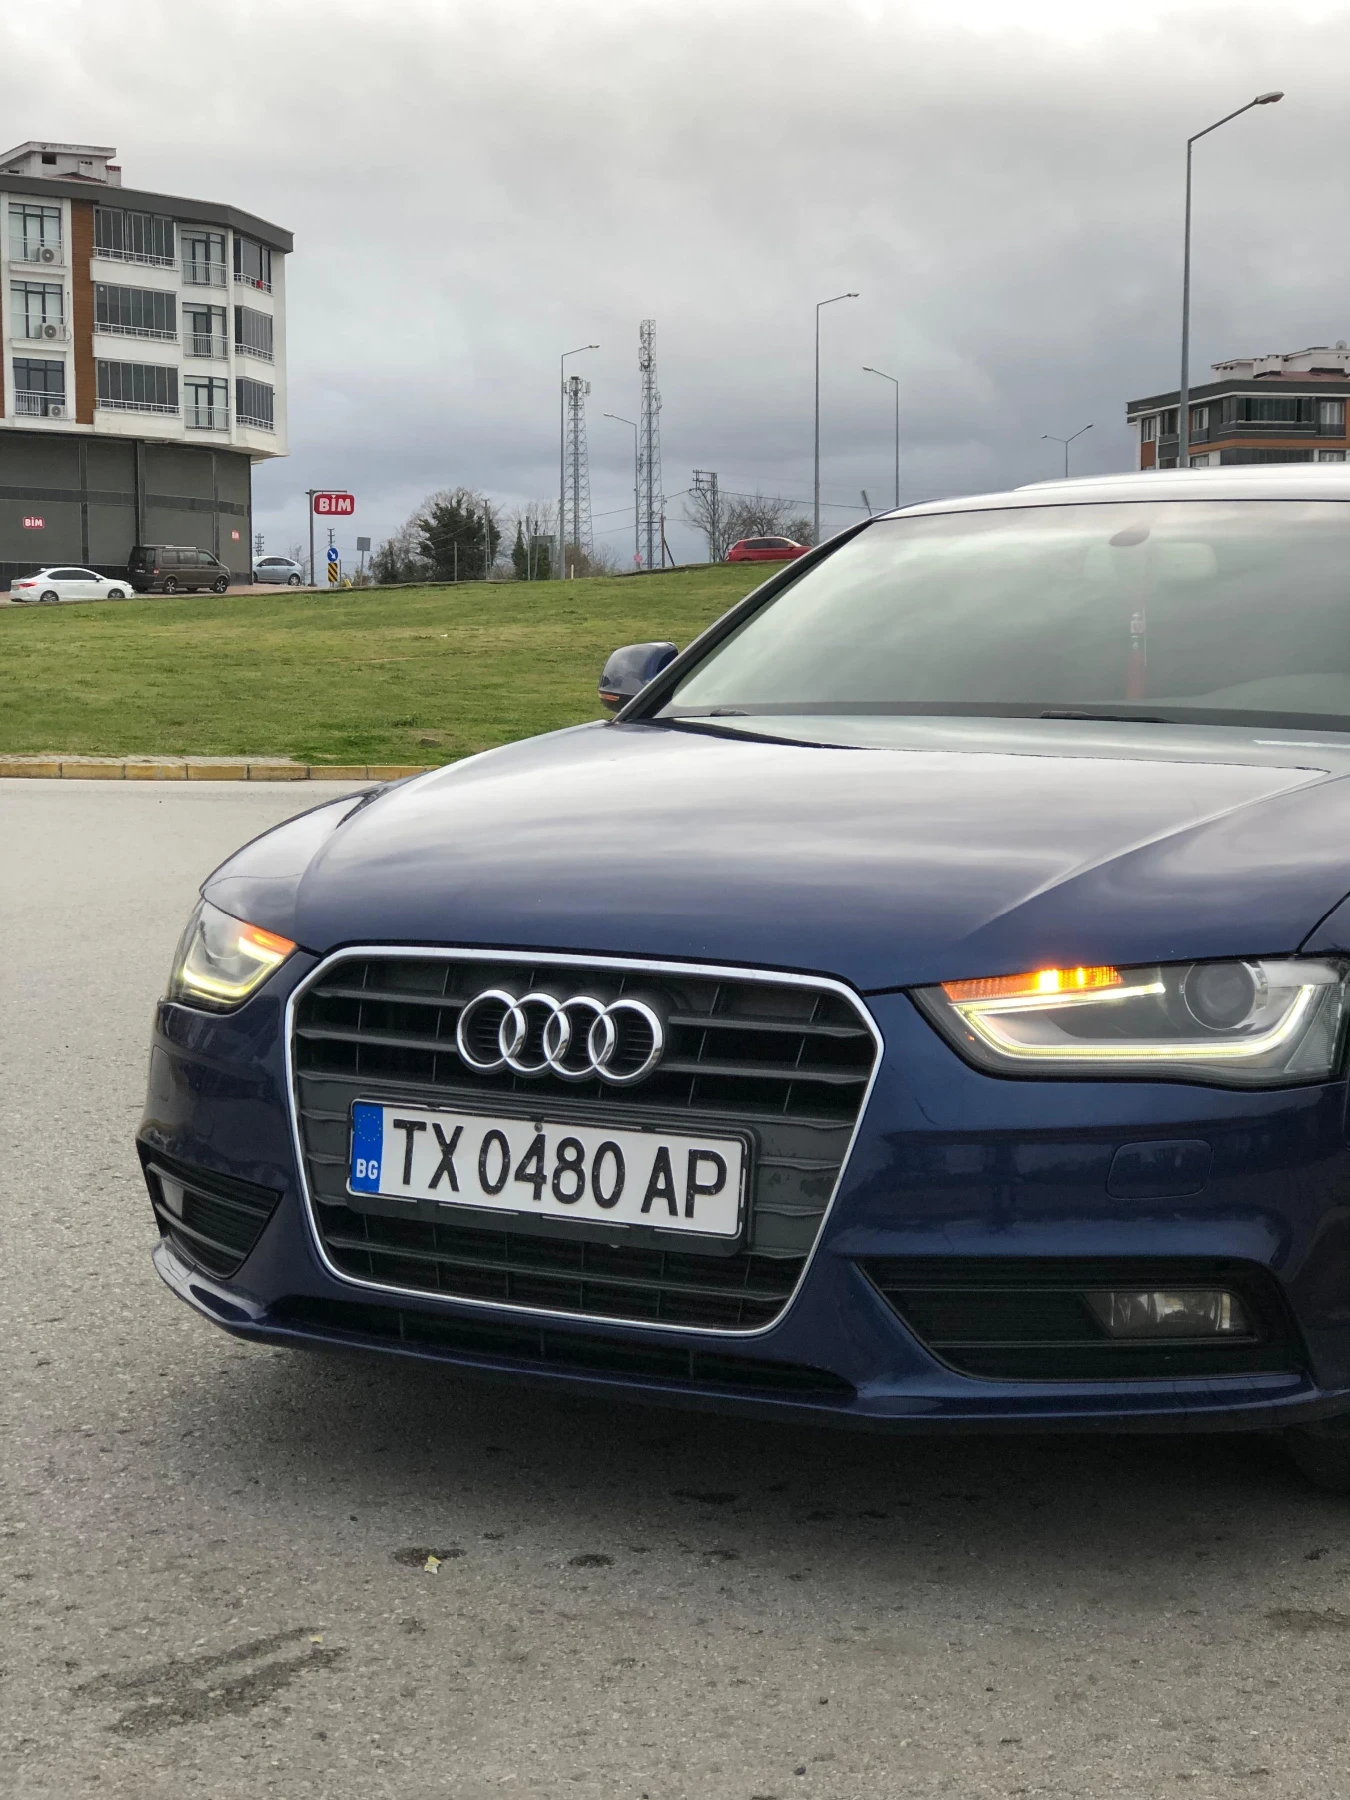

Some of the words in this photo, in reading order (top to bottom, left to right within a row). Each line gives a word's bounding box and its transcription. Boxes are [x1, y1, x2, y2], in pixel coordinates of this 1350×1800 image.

[355, 1158, 379, 1180] BG
[393, 1118, 464, 1192] TX
[478, 1129, 626, 1209] 0480
[640, 1146, 728, 1218] AP
